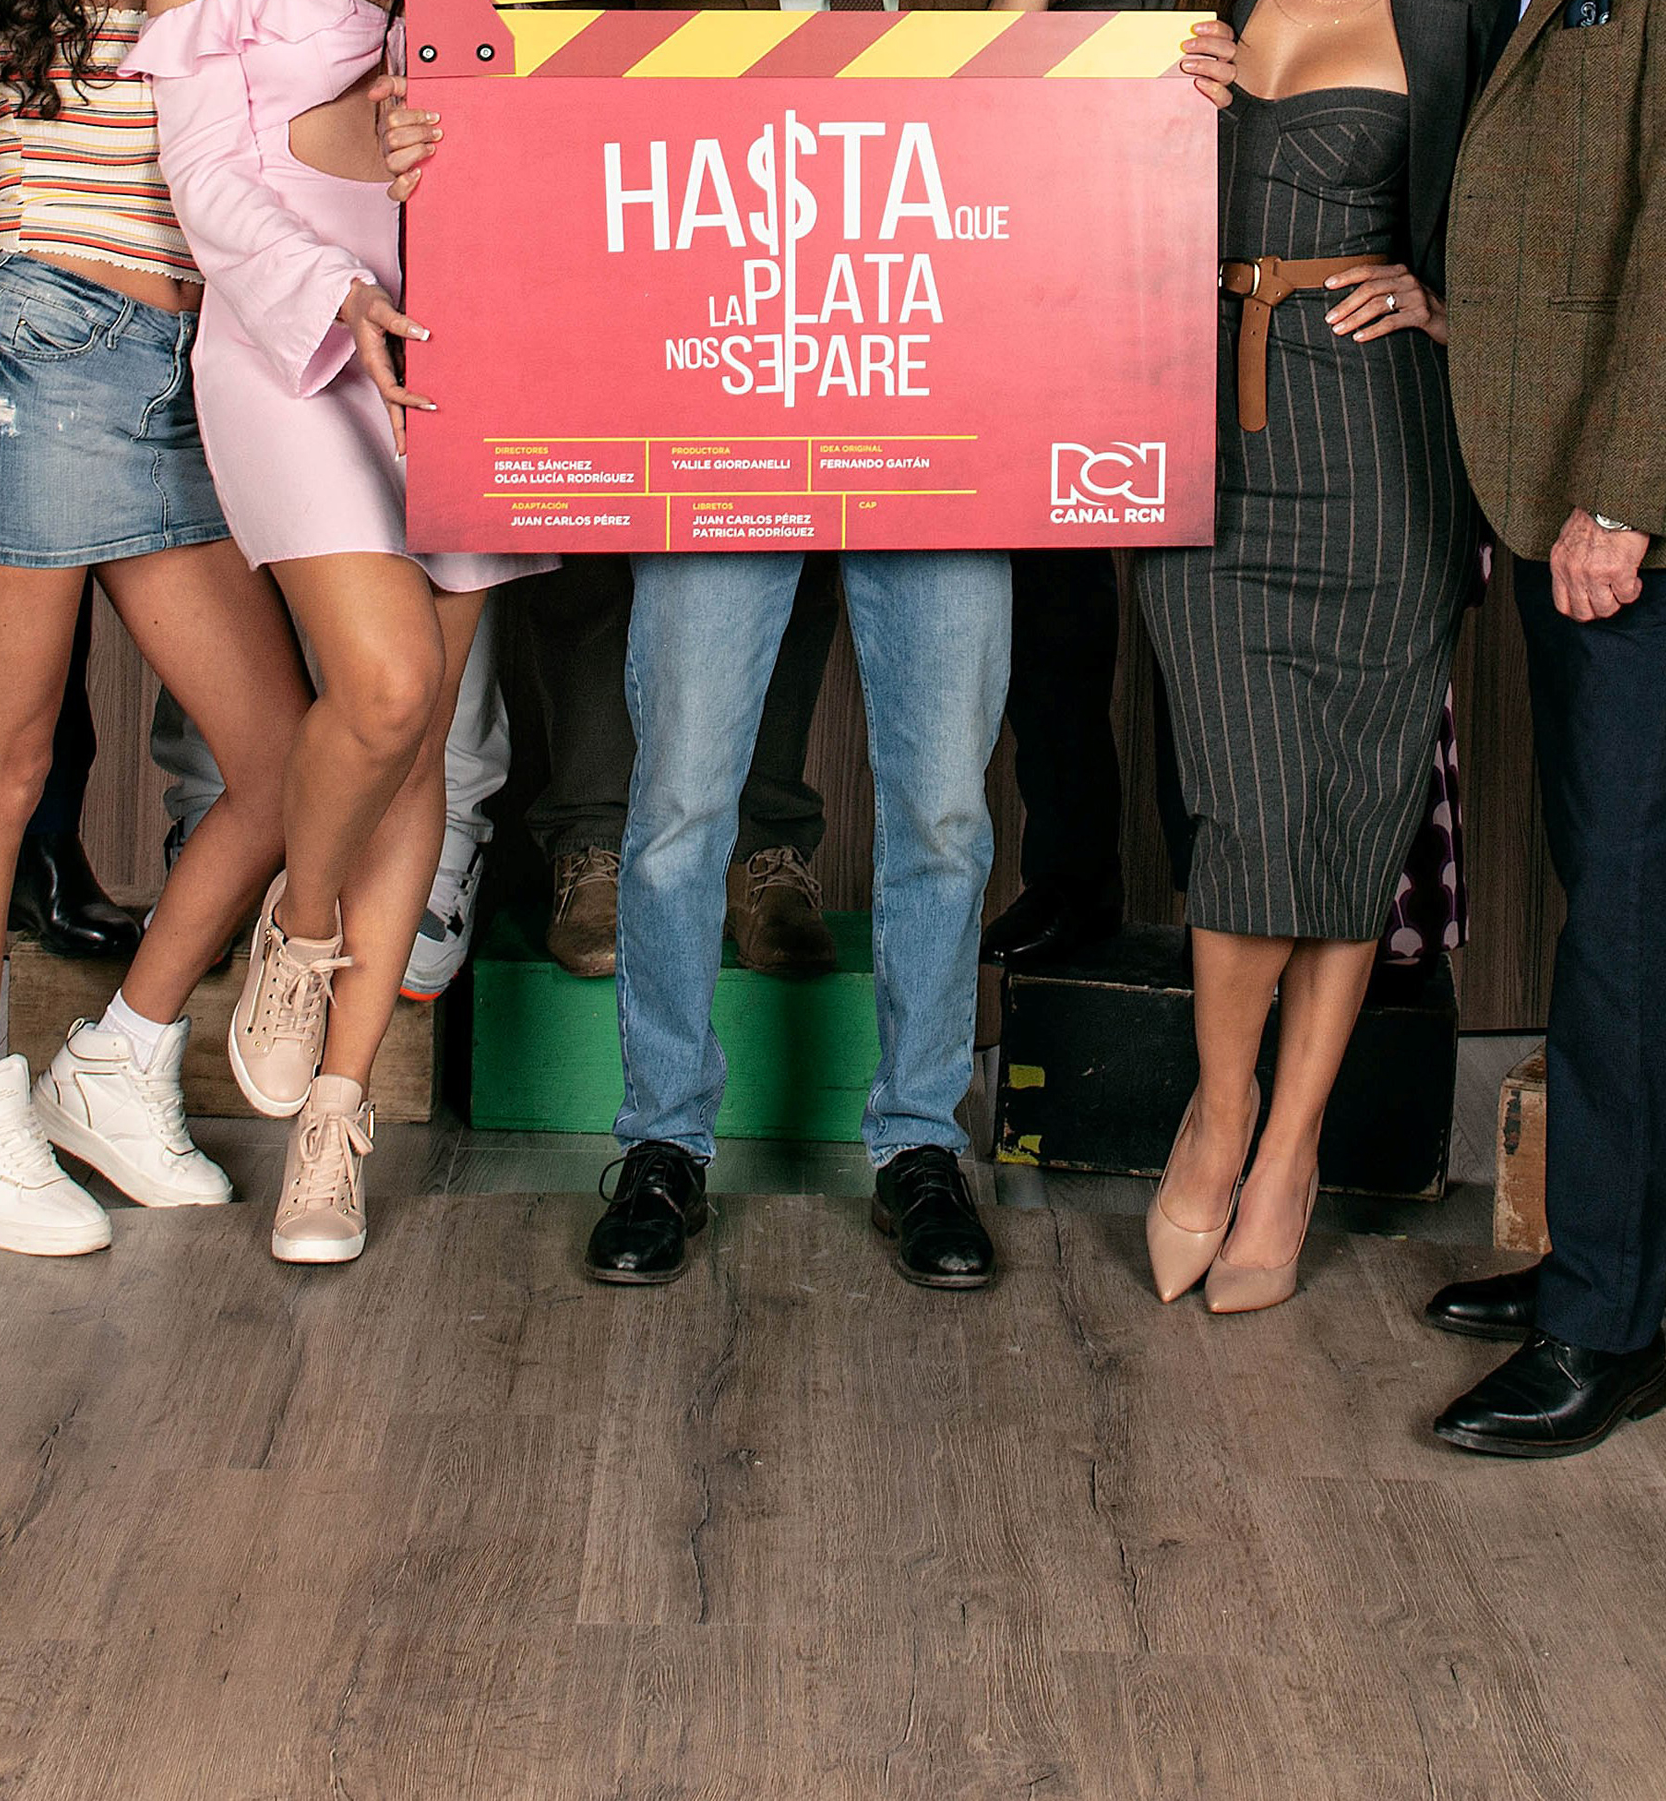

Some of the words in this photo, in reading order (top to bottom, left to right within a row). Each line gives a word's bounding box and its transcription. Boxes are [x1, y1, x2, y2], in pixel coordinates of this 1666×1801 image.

[954, 205, 1010, 240] QUE
[708, 294, 744, 327] LA
[744, 253, 944, 326] PLATA
[665, 336, 720, 370] NOS
[494, 446, 549, 455] DIRECTORES
[671, 446, 731, 455] PRODUCTORA
[819, 444, 841, 453] IDEA
[841, 444, 884, 453] ORIGINAL
[494, 461, 536, 470] ISRAEL
[537, 458, 592, 470] SÁNCHEZ
[671, 460, 712, 470] YALILE
[713, 458, 791, 470] GIORDANELLI
[819, 458, 884, 469] FERNANDO
[885, 456, 930, 469] GAITÁN
[494, 473, 528, 484] OLGA
[529, 471, 565, 483] LUCÍA
[566, 470, 635, 483] RODRÍGUEZ
[511, 502, 569, 511] ADAPTACIÓN
[692, 502, 734, 511] LIBRETOS
[858, 500, 878, 510] CAP
[510, 516, 543, 526] JUAN
[544, 516, 592, 526] CARLOS
[593, 513, 631, 526] PÉREZ
[692, 515, 724, 525] JUAN
[725, 515, 773, 525] CARLOS
[774, 512, 812, 525] PÉREZ
[1049, 508, 1120, 525] CANAL
[1123, 508, 1166, 524] RCN
[692, 528, 746, 538] PATRICIA
[747, 525, 815, 538] RODRÍGUEZ
